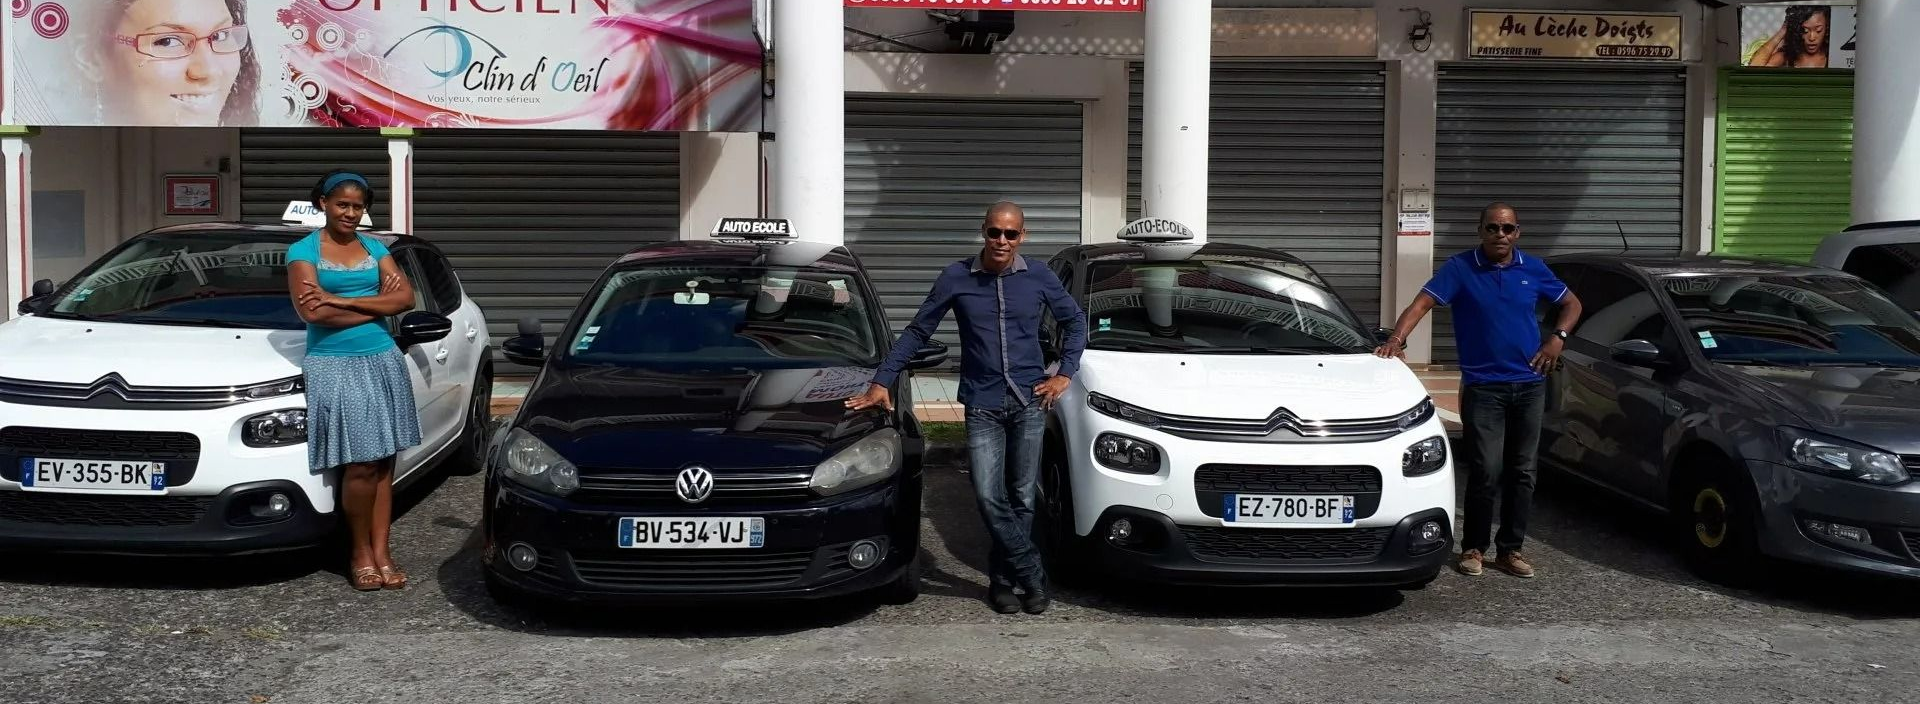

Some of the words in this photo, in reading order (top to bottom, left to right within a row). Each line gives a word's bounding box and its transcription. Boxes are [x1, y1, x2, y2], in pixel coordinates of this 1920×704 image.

[1499, 15, 1525, 36] Au
[1534, 15, 1587, 38] Lèche
[1595, 17, 1654, 43] Doigts
[1524, 47, 1543, 56] FINE
[1617, 46, 1636, 56] 0596
[1638, 47, 1648, 56] 75
[463, 55, 514, 91] Clin
[520, 56, 547, 91] d'
[552, 57, 610, 92] Oeil
[427, 94, 445, 103] Vos
[449, 95, 474, 104] yeux,
[478, 95, 502, 103] notre
[506, 94, 541, 104] sérieux
[723, 221, 751, 232] AUTO
[752, 222, 786, 233] ECOLE
[1125, 219, 1187, 236] AUTO-ECOLE
[38, 461, 148, 484] EV-355-BK
[1239, 497, 1339, 518] EZ-780-BF
[636, 521, 744, 543] BV-534-VJ
[750, 534, 762, 544] 972
